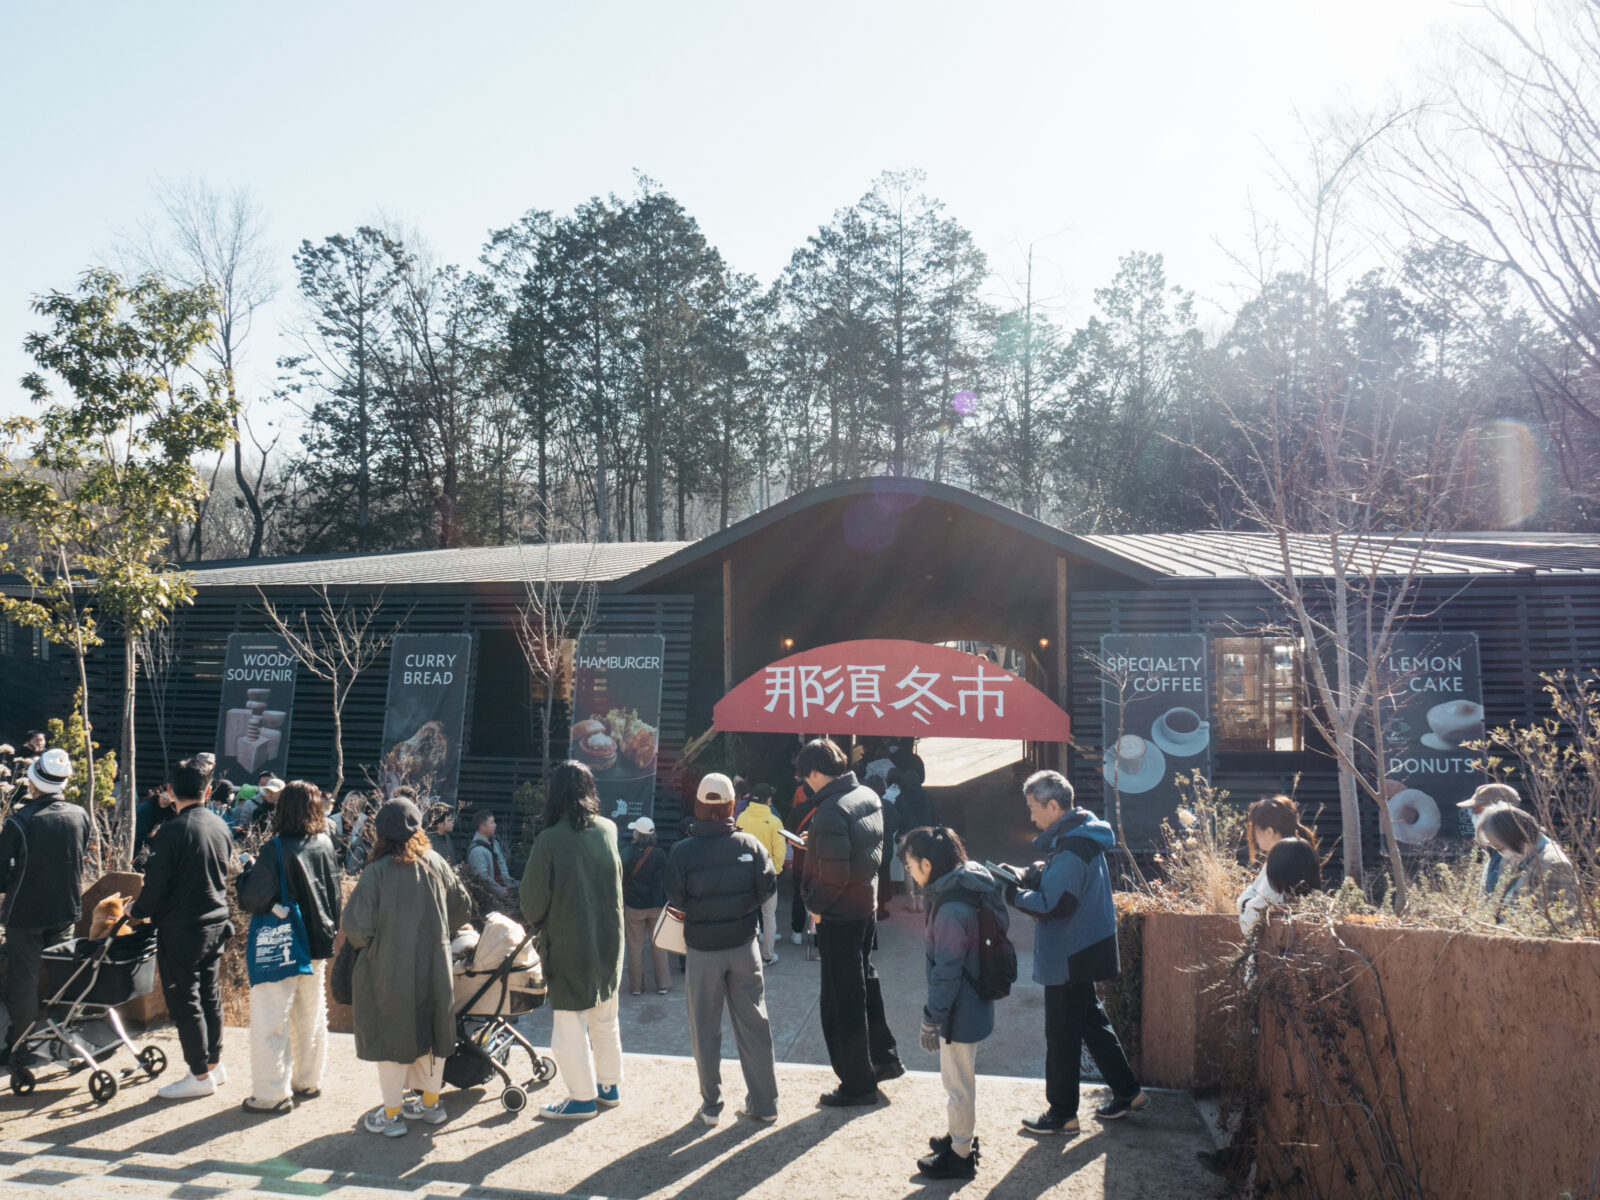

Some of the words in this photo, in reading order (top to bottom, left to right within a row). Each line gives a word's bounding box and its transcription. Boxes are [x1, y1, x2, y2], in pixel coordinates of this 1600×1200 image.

[405, 654, 457, 667] CURRY
[579, 656, 660, 670] HAMBURGER
[1107, 657, 1202, 672] SPECIALTY
[1389, 656, 1462, 672] LEMON
[227, 668, 293, 682] SOUVENIR
[403, 671, 454, 685] BREAD
[1133, 677, 1203, 692] COFFEE
[1409, 676, 1464, 692] CAKE
[763, 664, 1014, 726] 那須冬市
[1389, 758, 1476, 773] DONUTS
